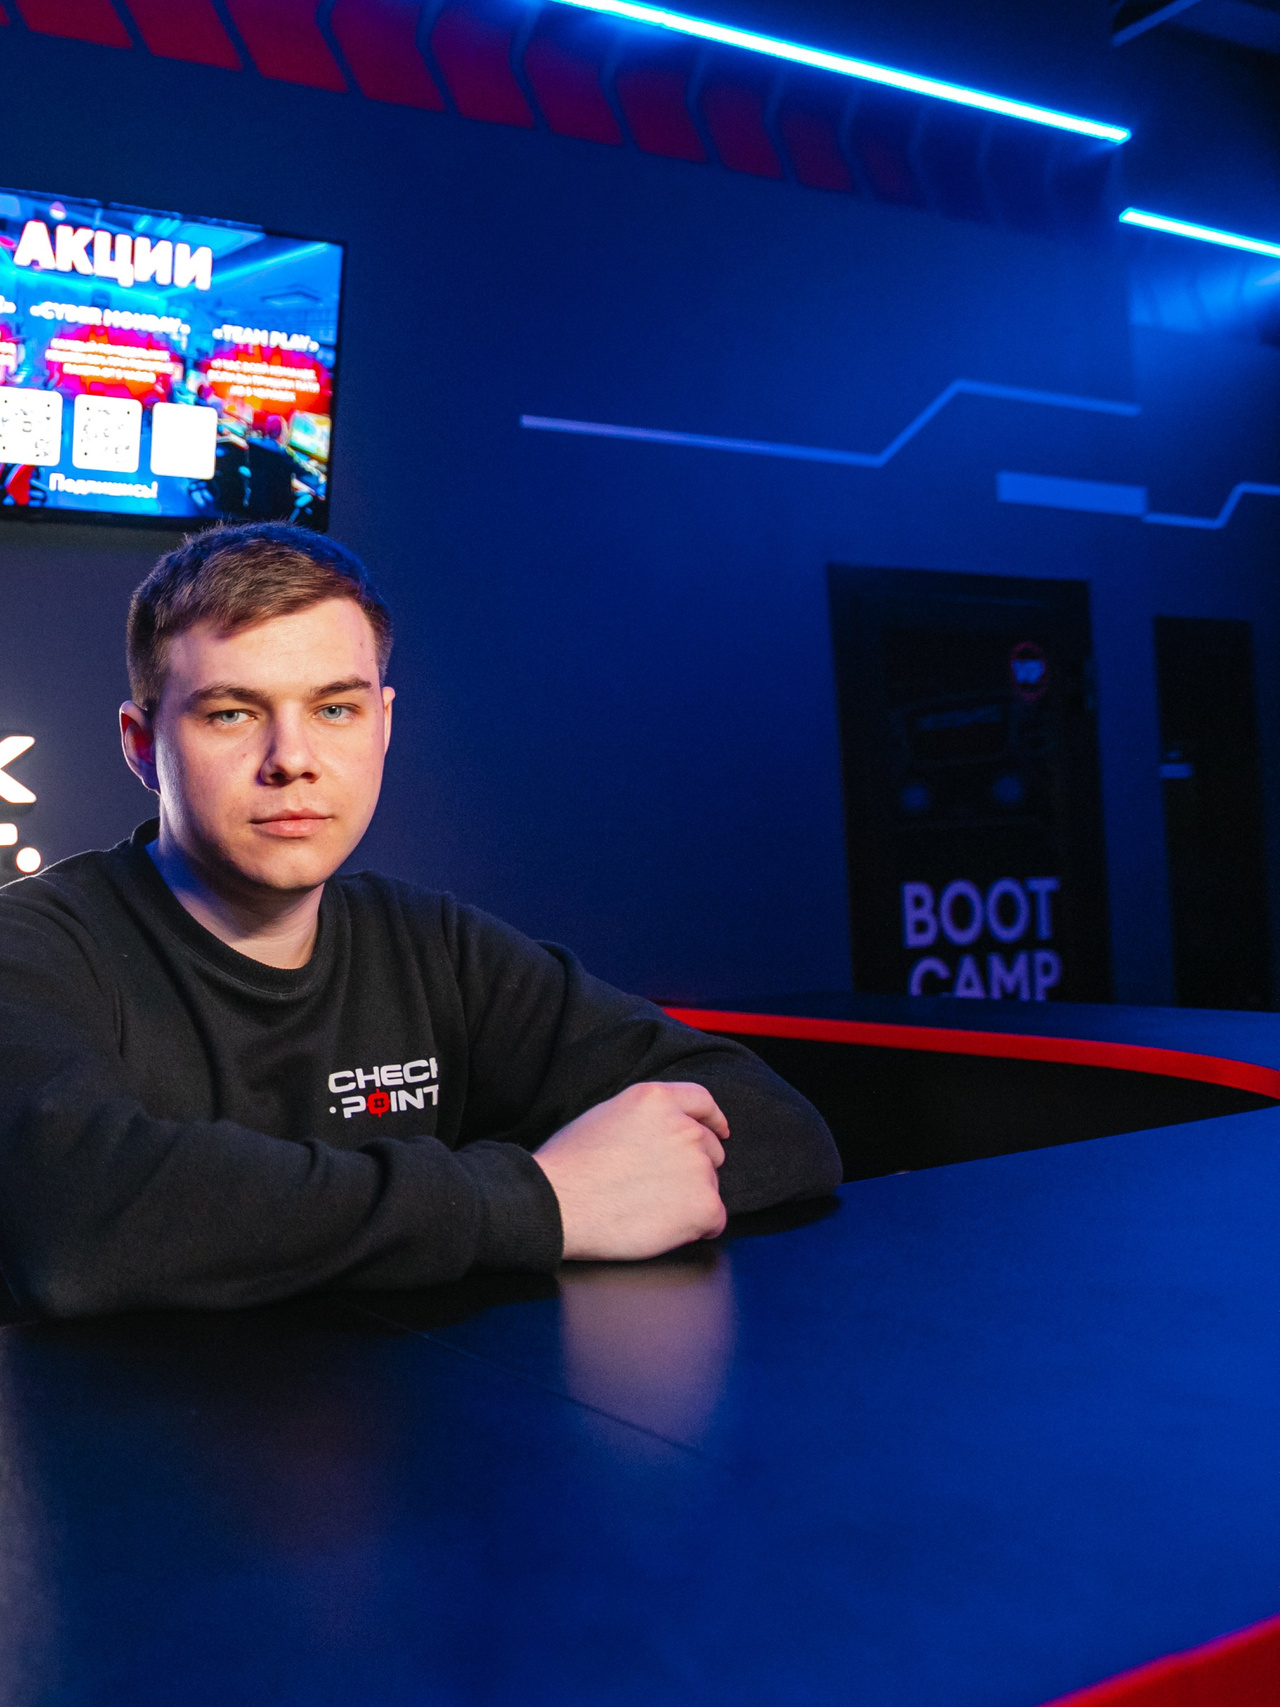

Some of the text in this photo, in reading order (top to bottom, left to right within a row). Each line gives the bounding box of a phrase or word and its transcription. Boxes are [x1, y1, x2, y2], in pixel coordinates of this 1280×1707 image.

[13, 219, 213, 291] АКЦИИ
[900, 875, 1061, 948] BOOT
[907, 949, 1062, 1001] CAMP
